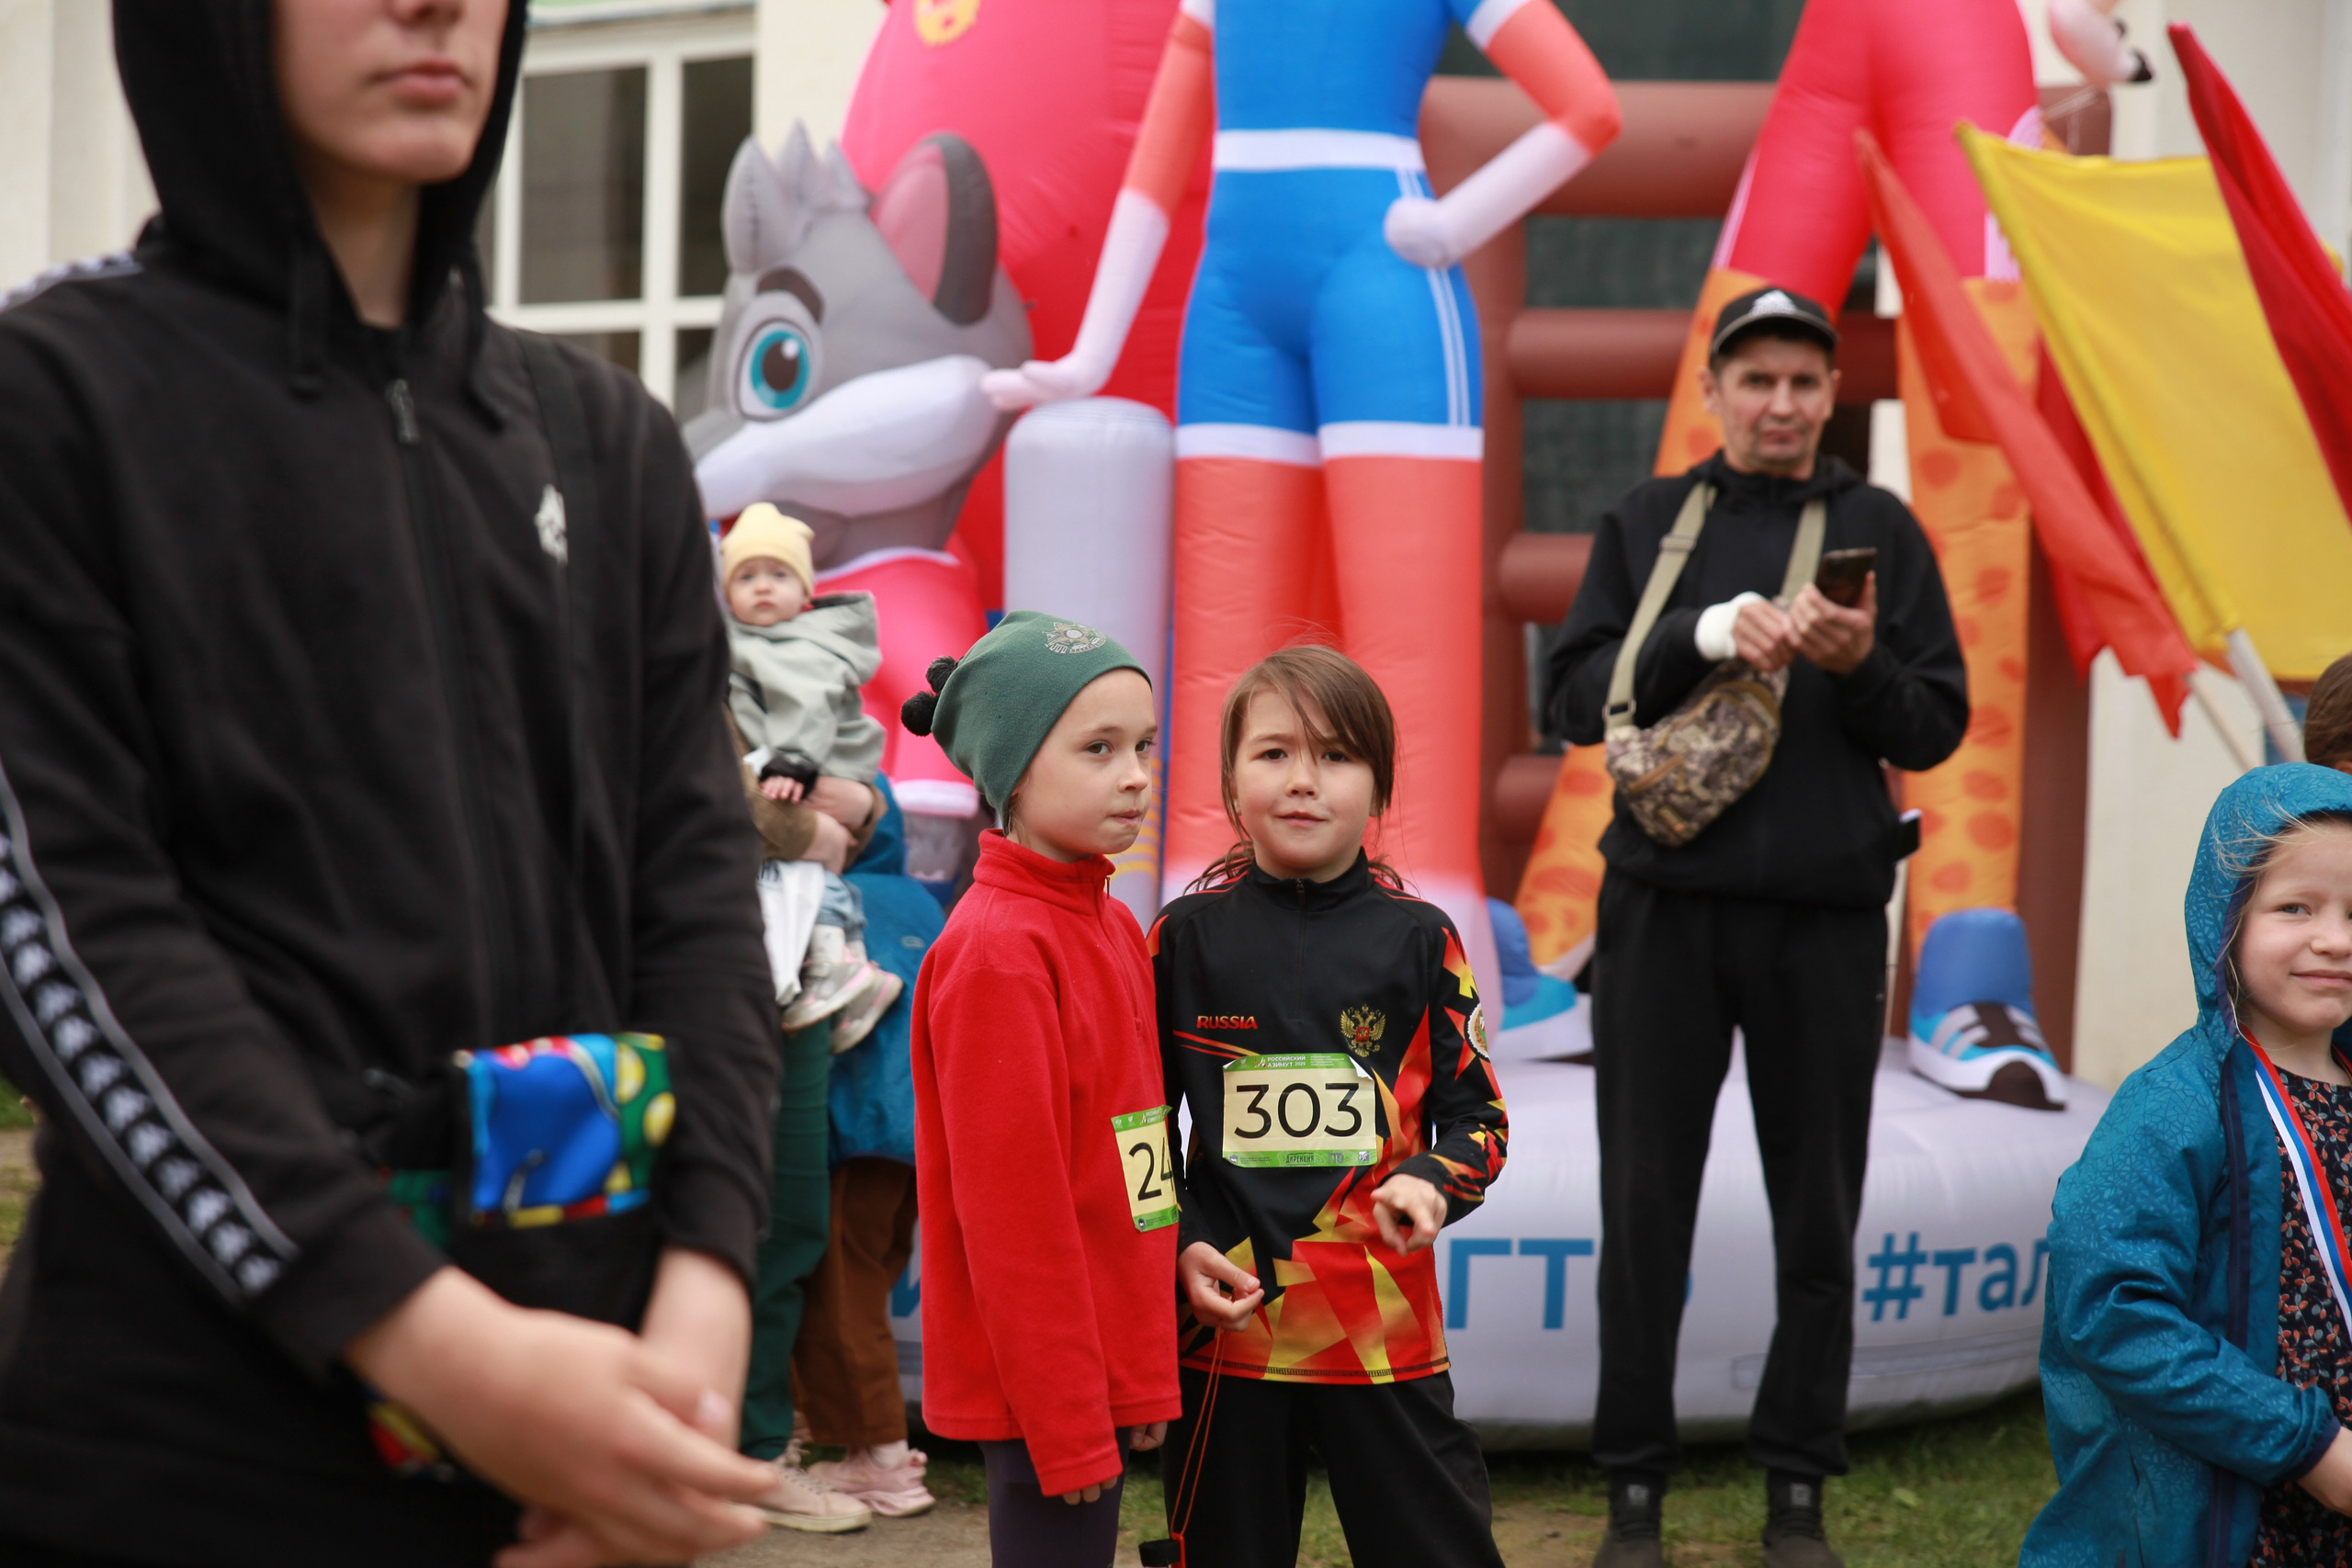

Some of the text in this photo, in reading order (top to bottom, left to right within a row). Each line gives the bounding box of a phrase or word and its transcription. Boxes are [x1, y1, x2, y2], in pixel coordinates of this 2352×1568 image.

[1196, 1015, 1259, 1030] RUSSIA
[1234, 1082, 1363, 1139] 303
[1128, 1136, 1174, 1201] 24
[1286, 1155, 1315, 1164] ДИРЕКЦИЯ
[1328, 1152, 1344, 1164] ГТО
[1445, 1237, 1692, 1330] ГТ
